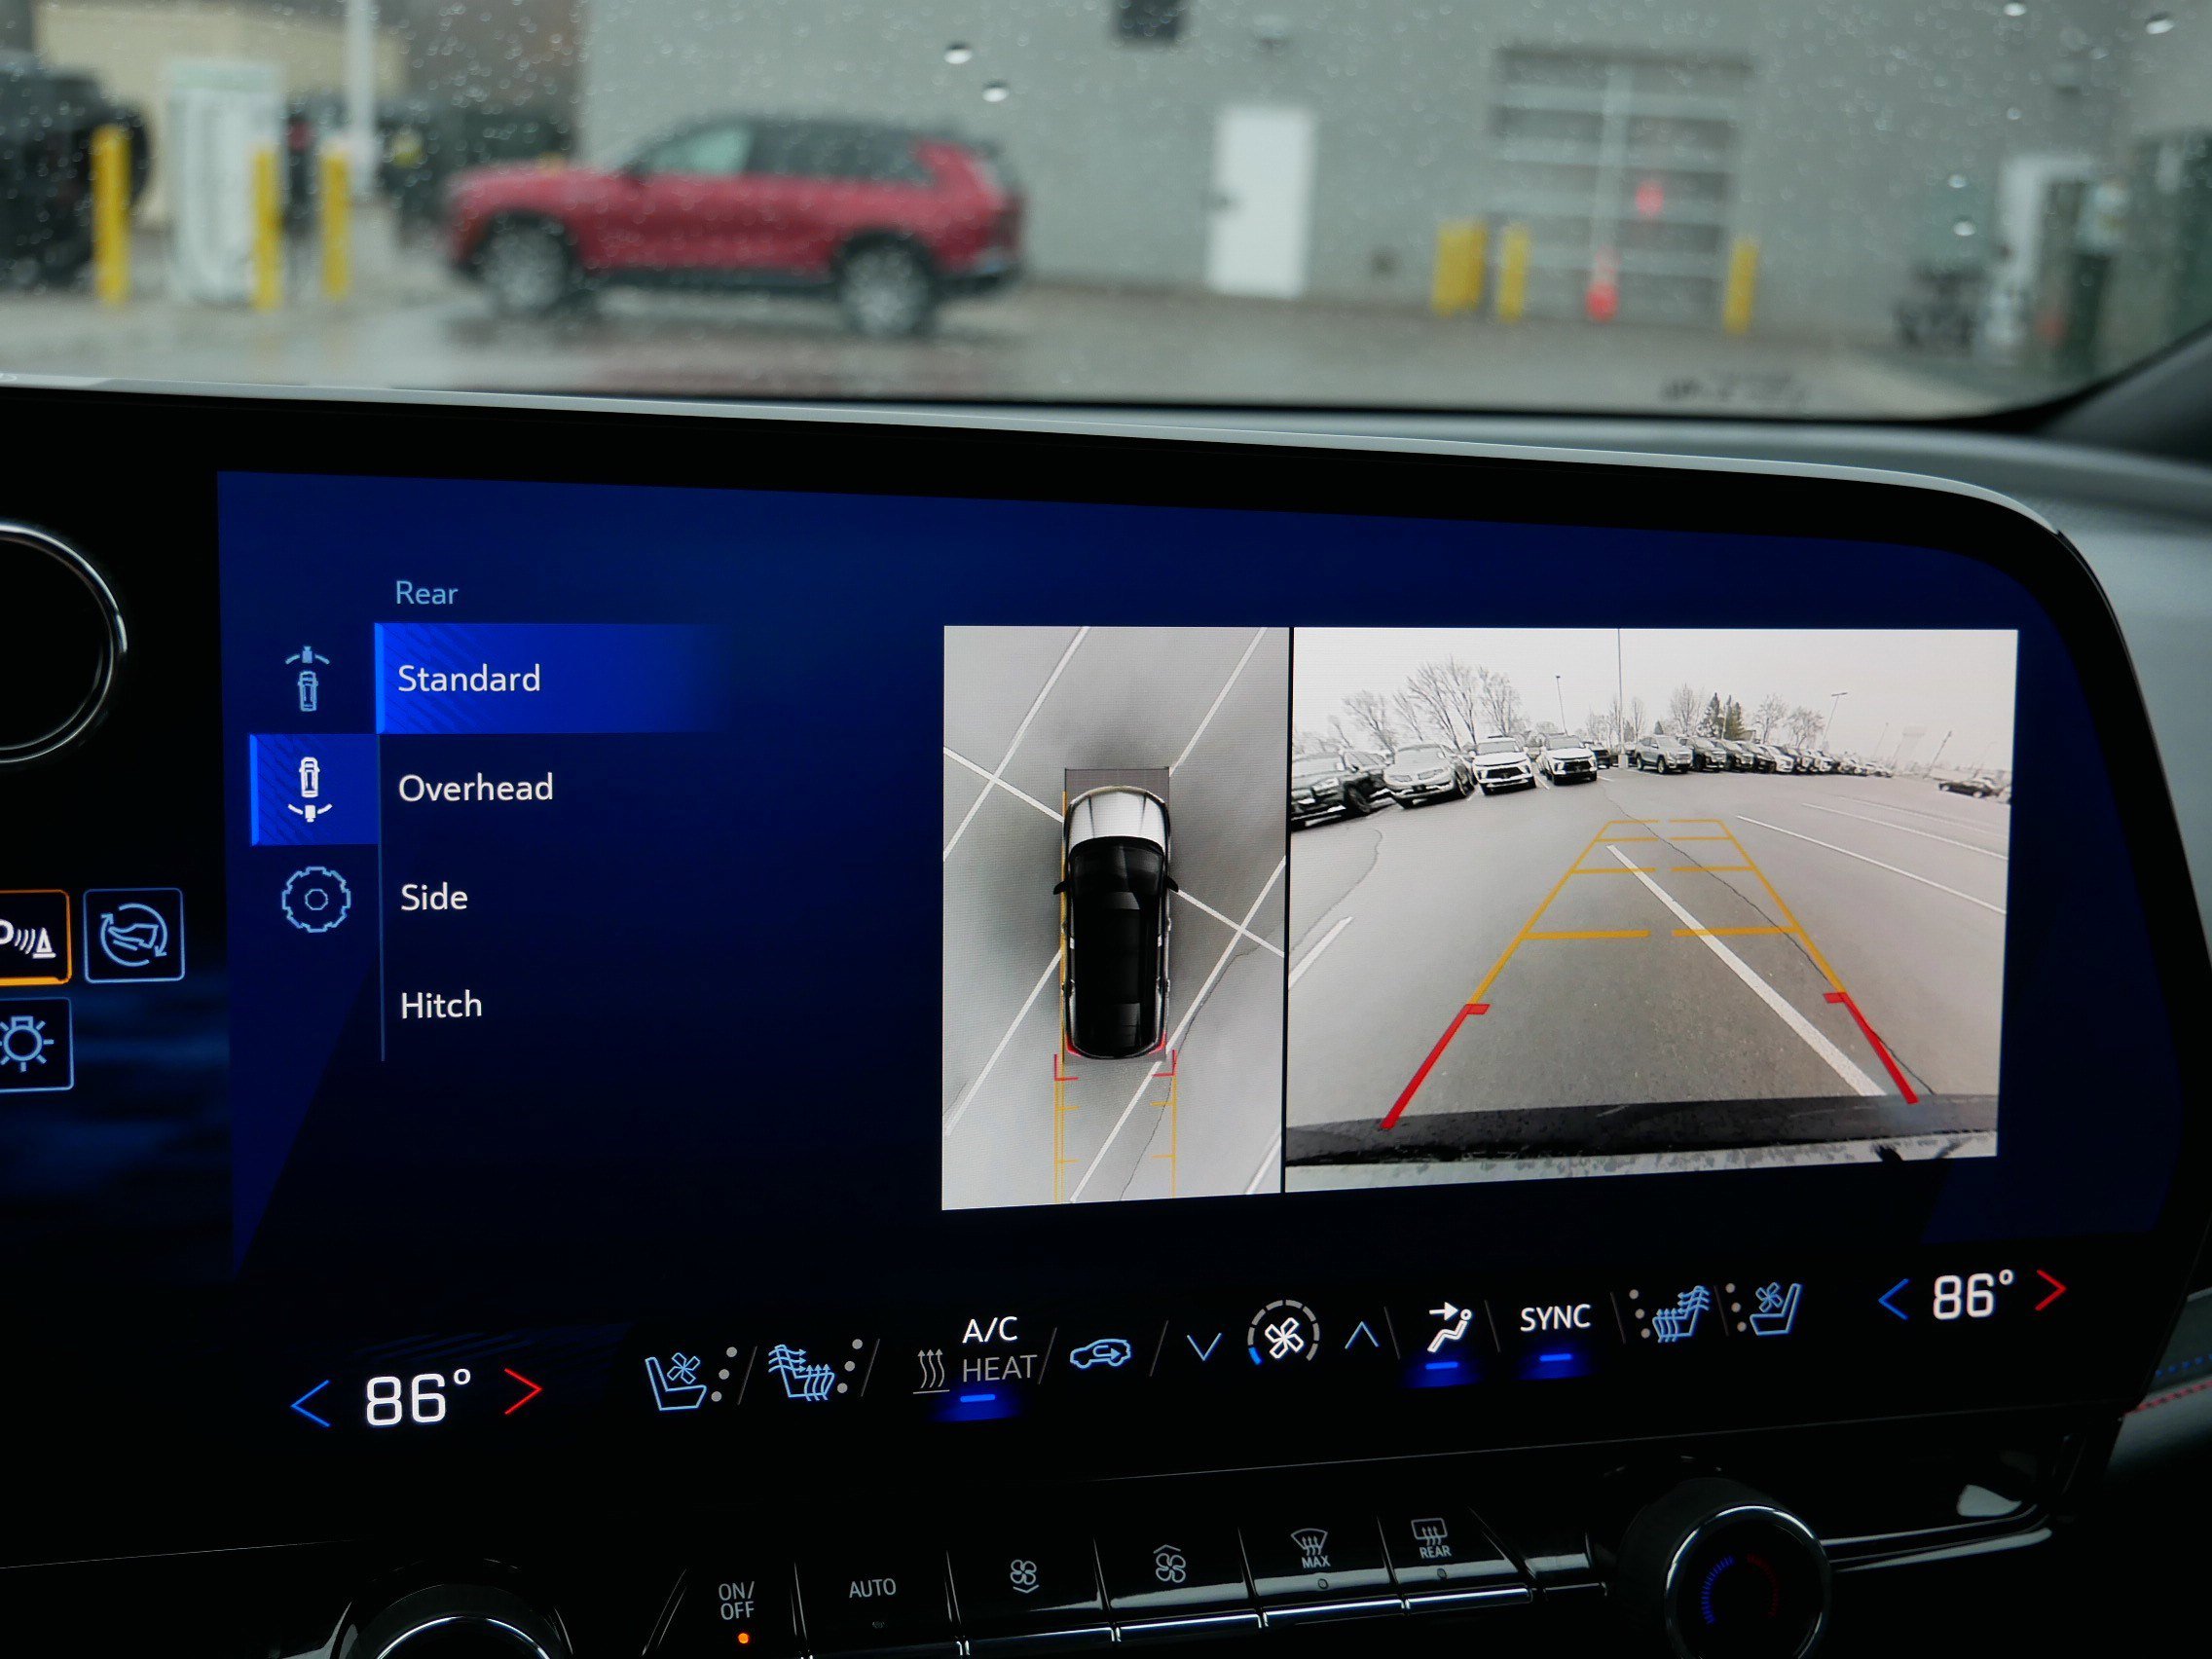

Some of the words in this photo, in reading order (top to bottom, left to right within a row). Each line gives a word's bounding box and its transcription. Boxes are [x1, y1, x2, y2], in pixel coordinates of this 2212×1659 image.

[395, 579, 459, 606] Rear
[398, 663, 541, 692] Standard
[398, 771, 554, 802] Overhead
[400, 881, 468, 911] Side
[401, 989, 483, 1019] Hitch
[1932, 1269, 2014, 1320] 86°
[961, 1315, 1018, 1344] A/C
[1520, 1303, 1592, 1332] SYNC
[962, 1354, 1038, 1382] HEAT
[365, 1368, 471, 1427] 86°
[1301, 1555, 1331, 1569] MAX
[1419, 1544, 1452, 1559] REAR
[718, 1580, 756, 1602] ON/
[848, 1577, 897, 1599] AUTO
[719, 1600, 756, 1621] OFF
